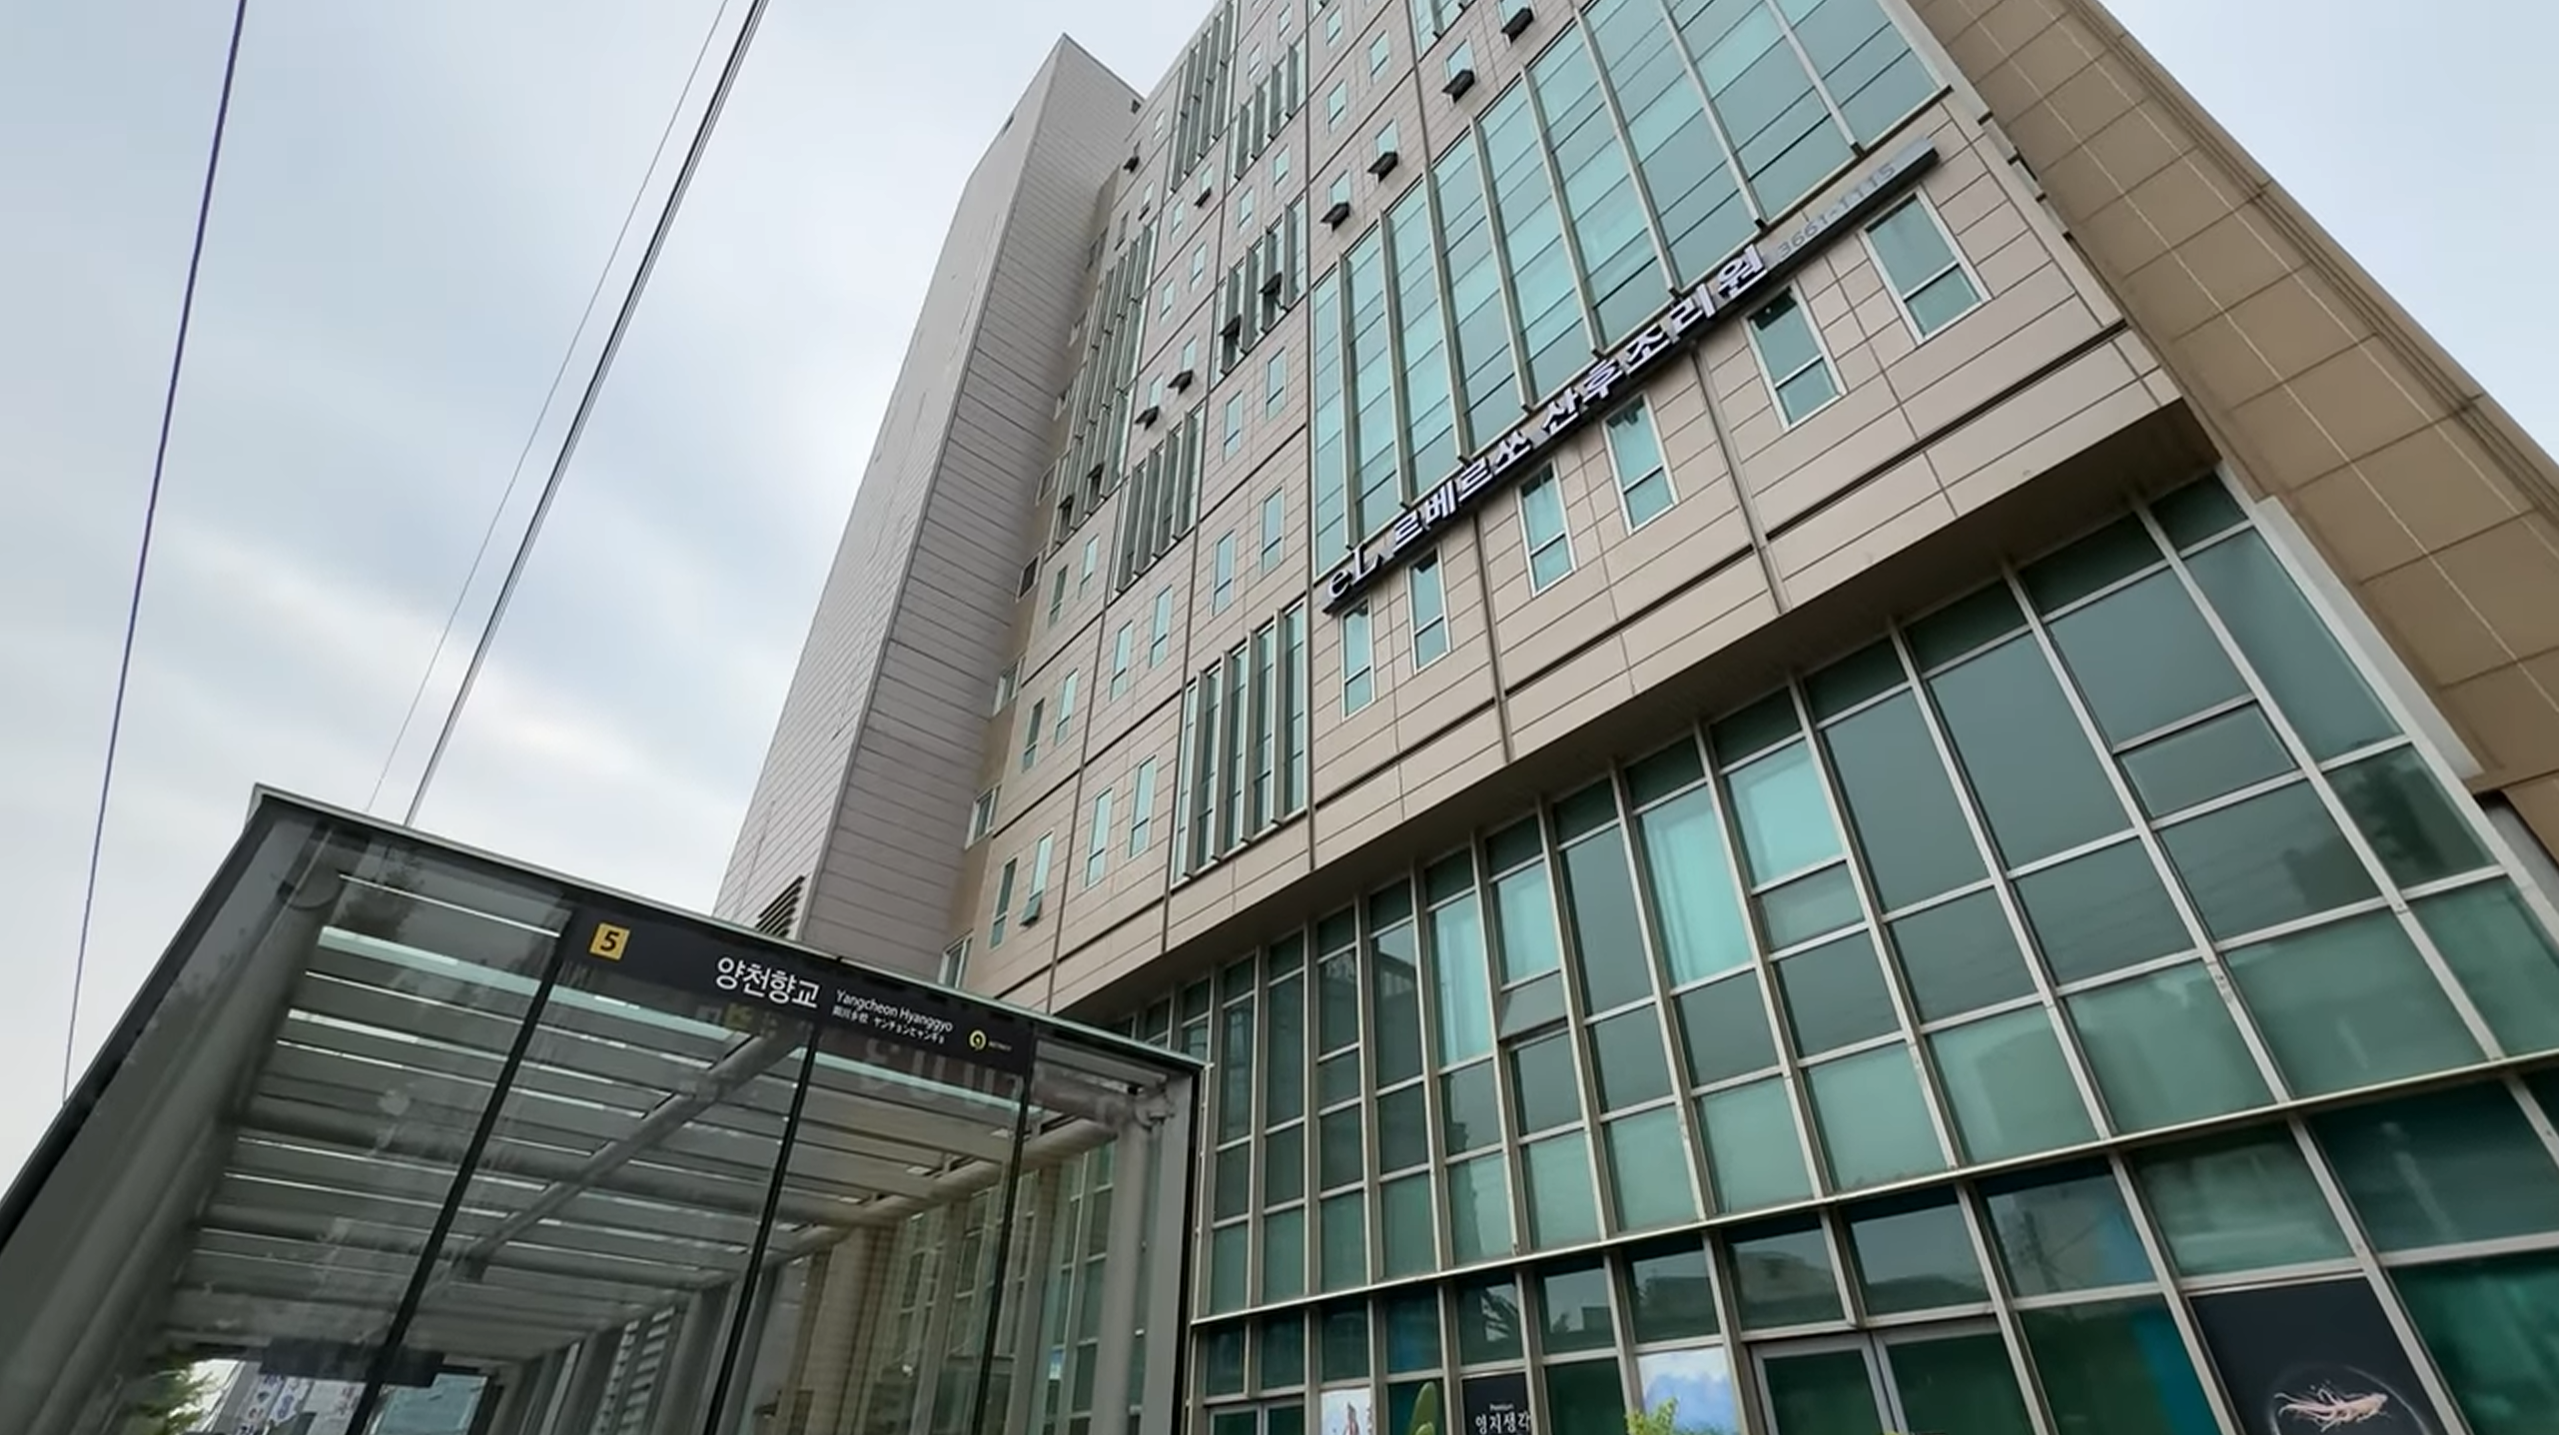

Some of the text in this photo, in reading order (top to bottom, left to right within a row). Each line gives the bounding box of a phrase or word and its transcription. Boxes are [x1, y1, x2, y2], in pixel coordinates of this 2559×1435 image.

[1393, 430, 1530, 553] 르베르쏘
[1542, 244, 1768, 435] 산후조리원
[1777, 163, 1895, 259] 3661-1115
[600, 931, 620, 952] 5
[716, 957, 820, 1008] 양천향교
[837, 989, 953, 1033] Yangcheon Hyanggyo
